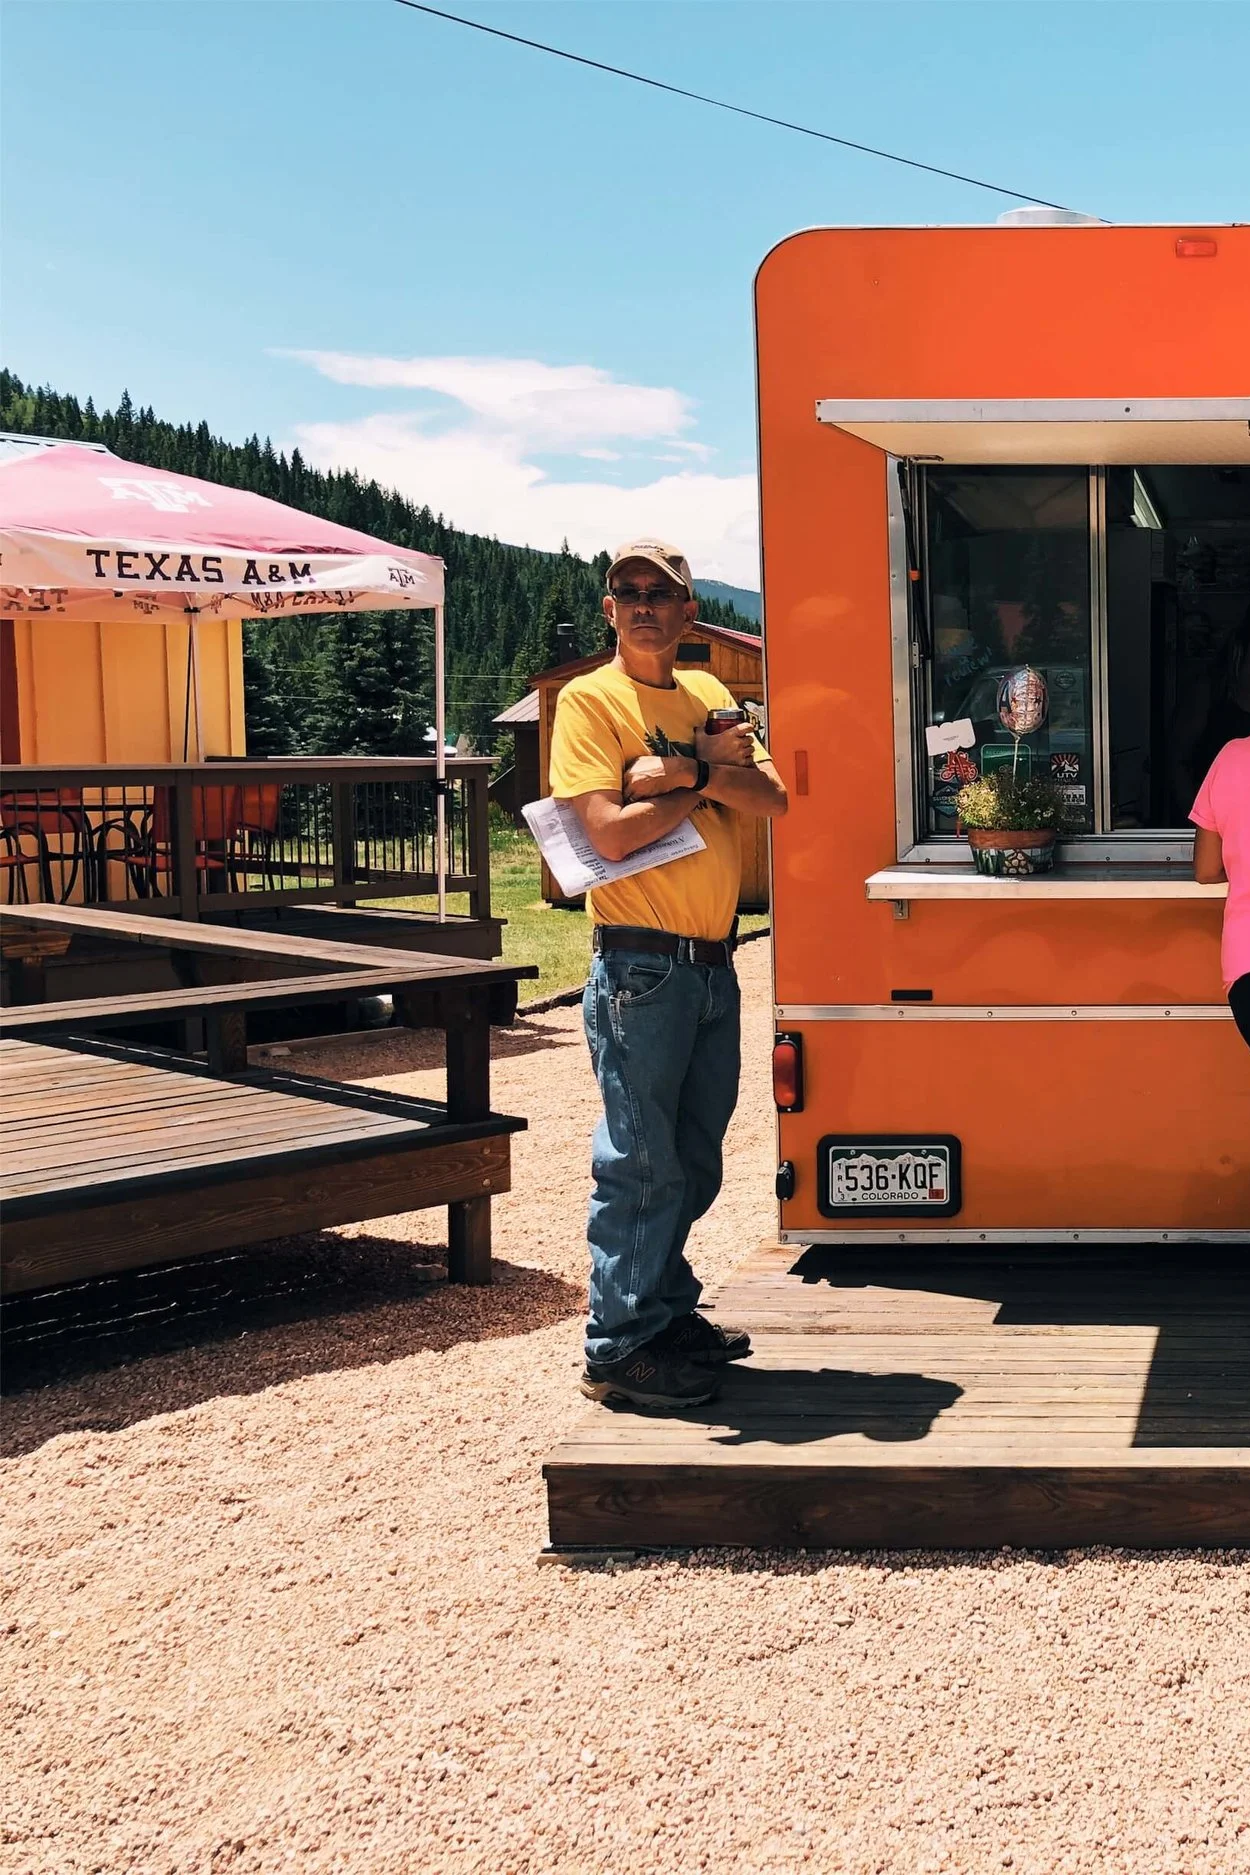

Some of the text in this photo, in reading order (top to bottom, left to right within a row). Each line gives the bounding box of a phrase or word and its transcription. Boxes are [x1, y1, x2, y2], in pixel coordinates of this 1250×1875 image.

[86, 548, 318, 586] TEXAS A&M
[862, 1192, 919, 1200] COLORADO
